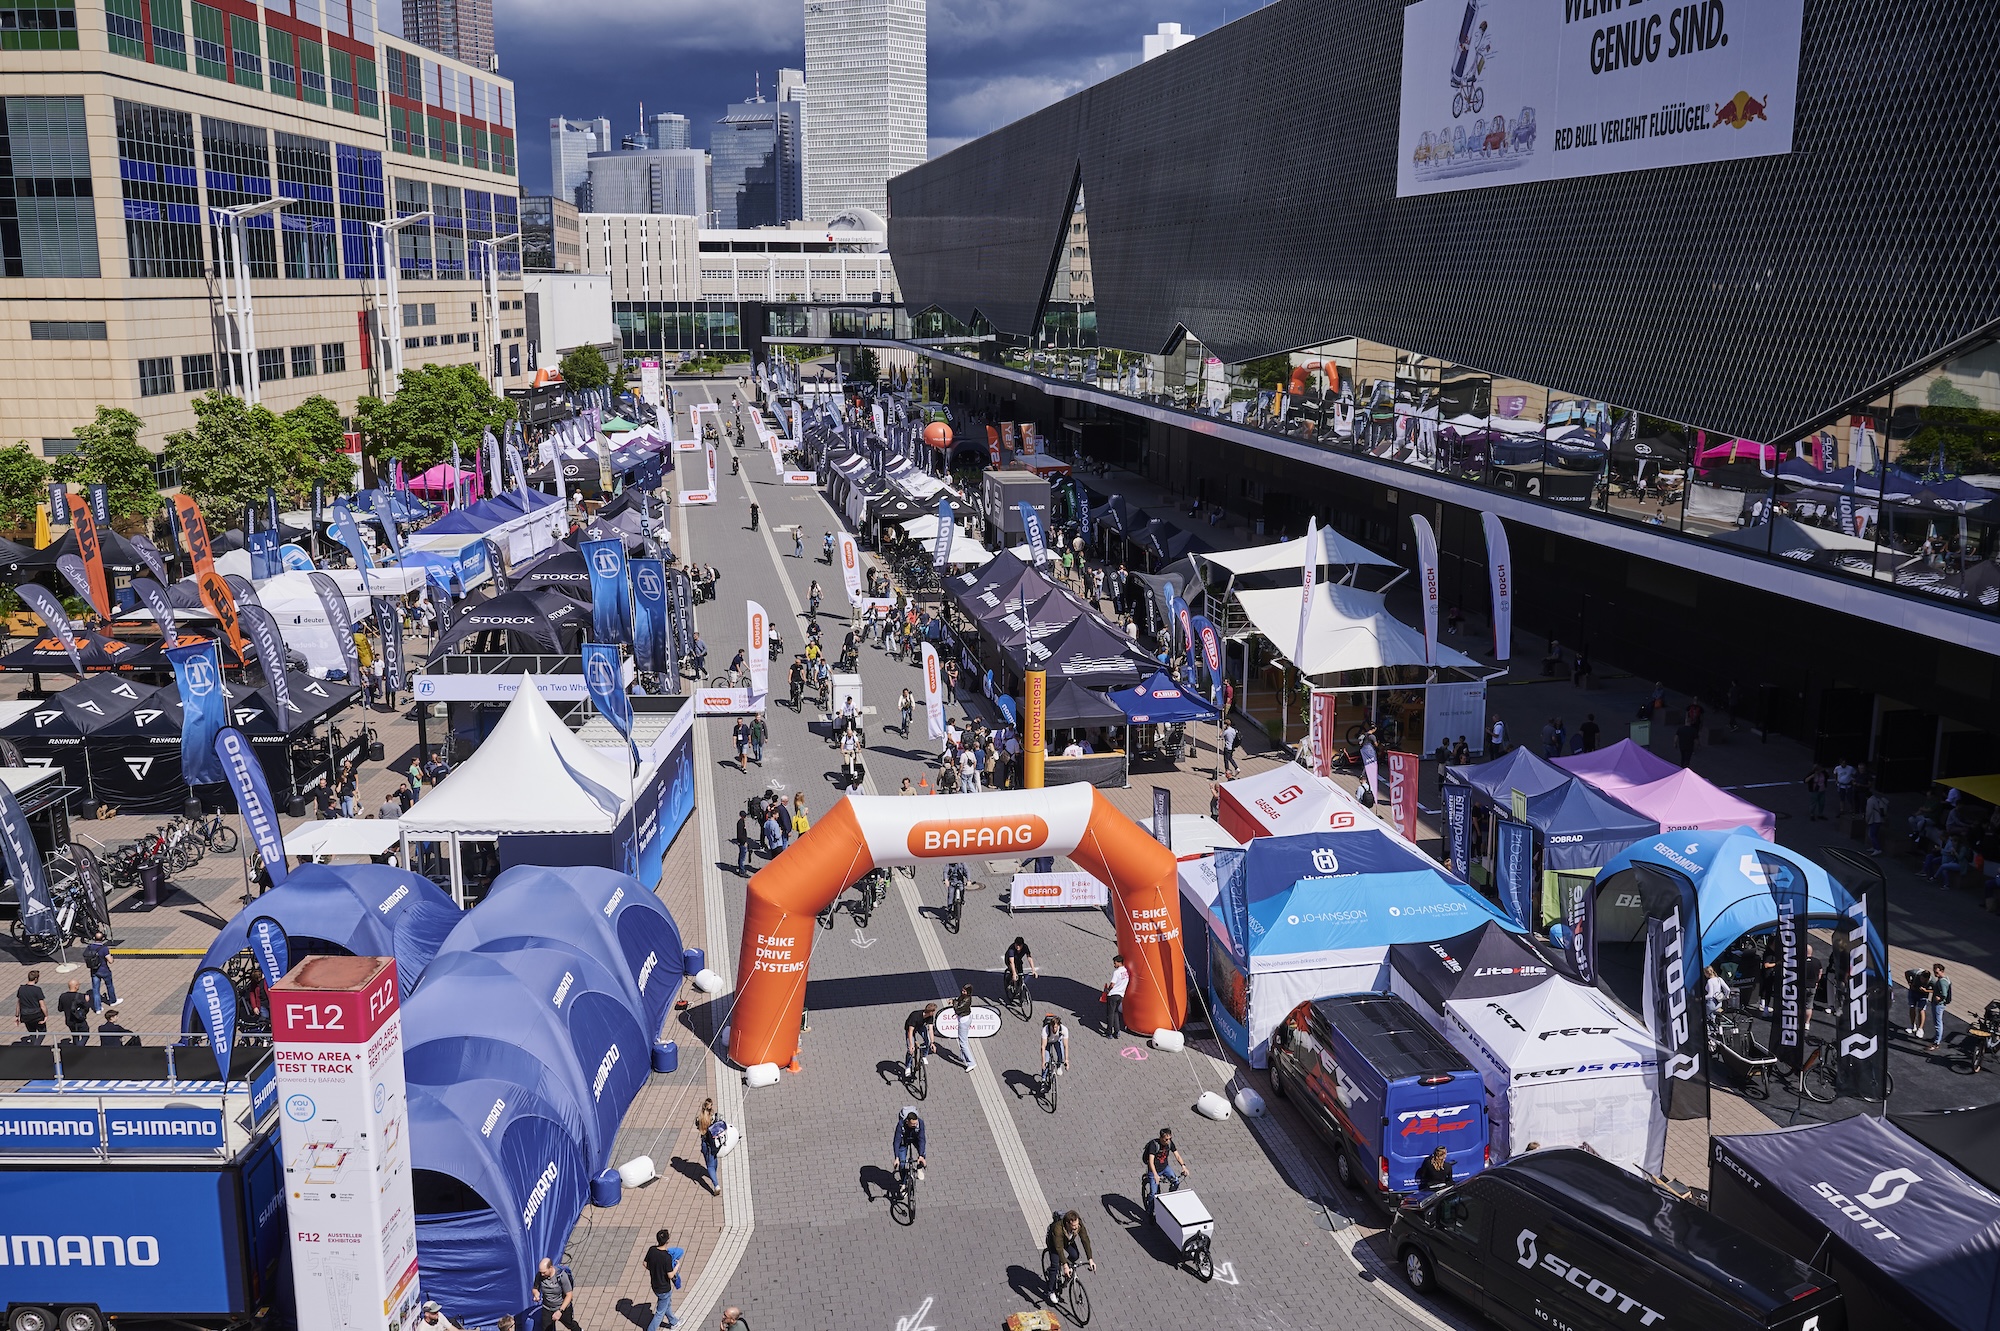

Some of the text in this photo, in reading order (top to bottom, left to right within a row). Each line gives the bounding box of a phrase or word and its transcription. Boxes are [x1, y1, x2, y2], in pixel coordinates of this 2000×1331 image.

[1590, 0, 1728, 75] GENUG SIND.
[1554, 129, 1573, 151] RED
[1575, 123, 1597, 148] BULL
[1601, 114, 1647, 144] VERLEIHT
[976, 498, 986, 532] SIMPLON
[1081, 499, 1090, 533] eovolt
[530, 573, 589, 581] STORCK
[977, 590, 1001, 608] pinion
[303, 616, 324, 624] deuter
[469, 616, 535, 625] STORCK
[548, 603, 576, 621] STORCK
[419, 682, 434, 693] ZF
[550, 683, 568, 692] Two
[569, 683, 588, 692] Whe
[1154, 690, 1179, 698] ABUS
[1033, 677, 1041, 747] REGISTRATION
[252, 735, 284, 743] RAYMON
[302, 769, 328, 795] RAYMON
[1254, 797, 1281, 820] GASGAS
[924, 824, 1032, 851] BAFANG
[1550, 834, 1583, 844] JOBRAD
[1652, 841, 1704, 876] BERGAMONT
[1027, 886, 1058, 895] BAFANG
[1071, 879, 1091, 887] E-Bike
[378, 884, 409, 915] SHIMANO
[603, 886, 626, 918] SHIMANO
[1071, 893, 1096, 901] Systems
[1132, 906, 1167, 919] E-BIKE
[1132, 919, 1167, 932] DRIVE
[757, 934, 794, 947] E-BIKE
[1133, 928, 1179, 945] SYSTEMS
[755, 947, 791, 959] DRIVE
[1429, 943, 1463, 972] Liteville
[637, 949, 658, 998] SHIMANO
[754, 959, 804, 973] SYSTEMS
[1473, 966, 1547, 977] Liteville
[552, 970, 575, 1009] SHIMANO
[369, 978, 394, 1022] F12
[286, 1003, 344, 1030] F12
[1486, 1002, 1527, 1032] FELT
[367, 1023, 398, 1058] DEMO AREA
[1446, 1009, 1509, 1075] FELT IS FAST
[1537, 1027, 1619, 1042] FELT
[276, 1051, 313, 1061] DEMO
[317, 1052, 351, 1061] AREA
[368, 1055, 381, 1070] TEST
[381, 1034, 399, 1055] TRACK
[277, 1063, 353, 1074] TEST TRACK
[591, 1042, 620, 1104] SHIMANO
[1513, 1063, 1604, 1081] FELT IS
[480, 1097, 506, 1138] SHIMANO
[1397, 1105, 1470, 1123] FELT
[112, 1120, 217, 1136] SHIMANO
[1400, 1119, 1475, 1138] FAST
[1722, 1155, 1761, 1189] SCOTT
[522, 1160, 558, 1229] SHIMANO
[1809, 1181, 1902, 1242] SCOTT
[298, 1232, 320, 1242] F12
[1539, 1252, 1665, 1327] SCOTT
[1535, 1307, 1548, 1321] NO
